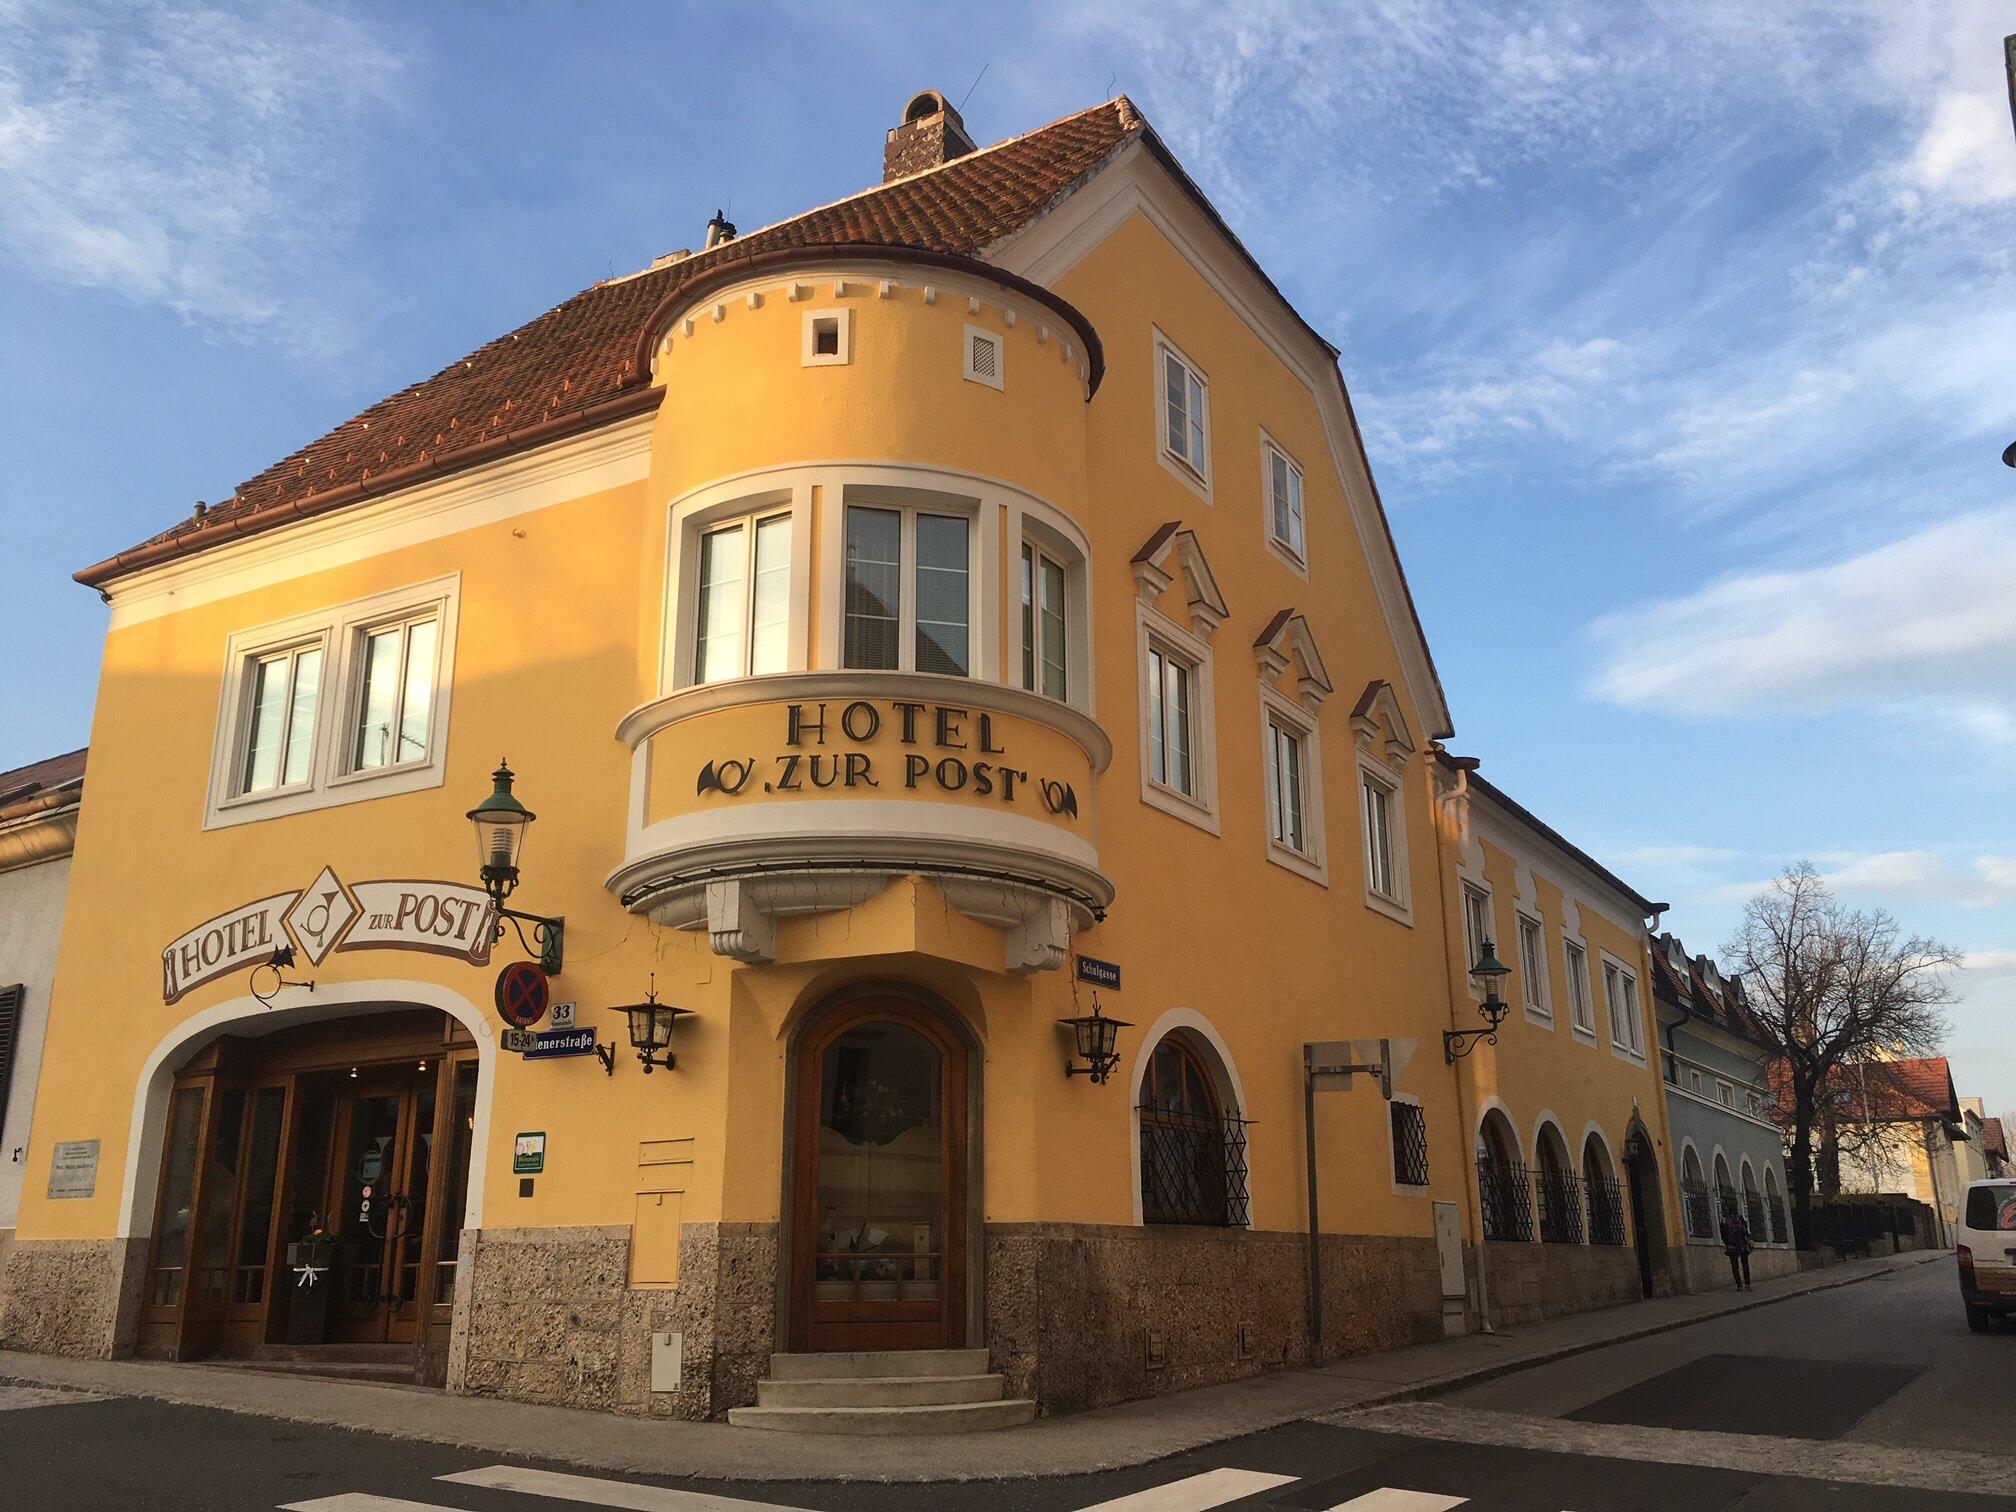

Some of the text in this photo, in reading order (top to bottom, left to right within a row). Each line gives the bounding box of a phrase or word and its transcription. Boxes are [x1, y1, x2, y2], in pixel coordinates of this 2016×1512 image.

[787, 702, 1005, 754] HOTEL
[180, 893, 481, 981] HOTEL ZUR POST
[1082, 962, 1117, 981] Schulgasse
[553, 1004, 571, 1020] 33
[535, 1033, 592, 1050] ienerstraße
